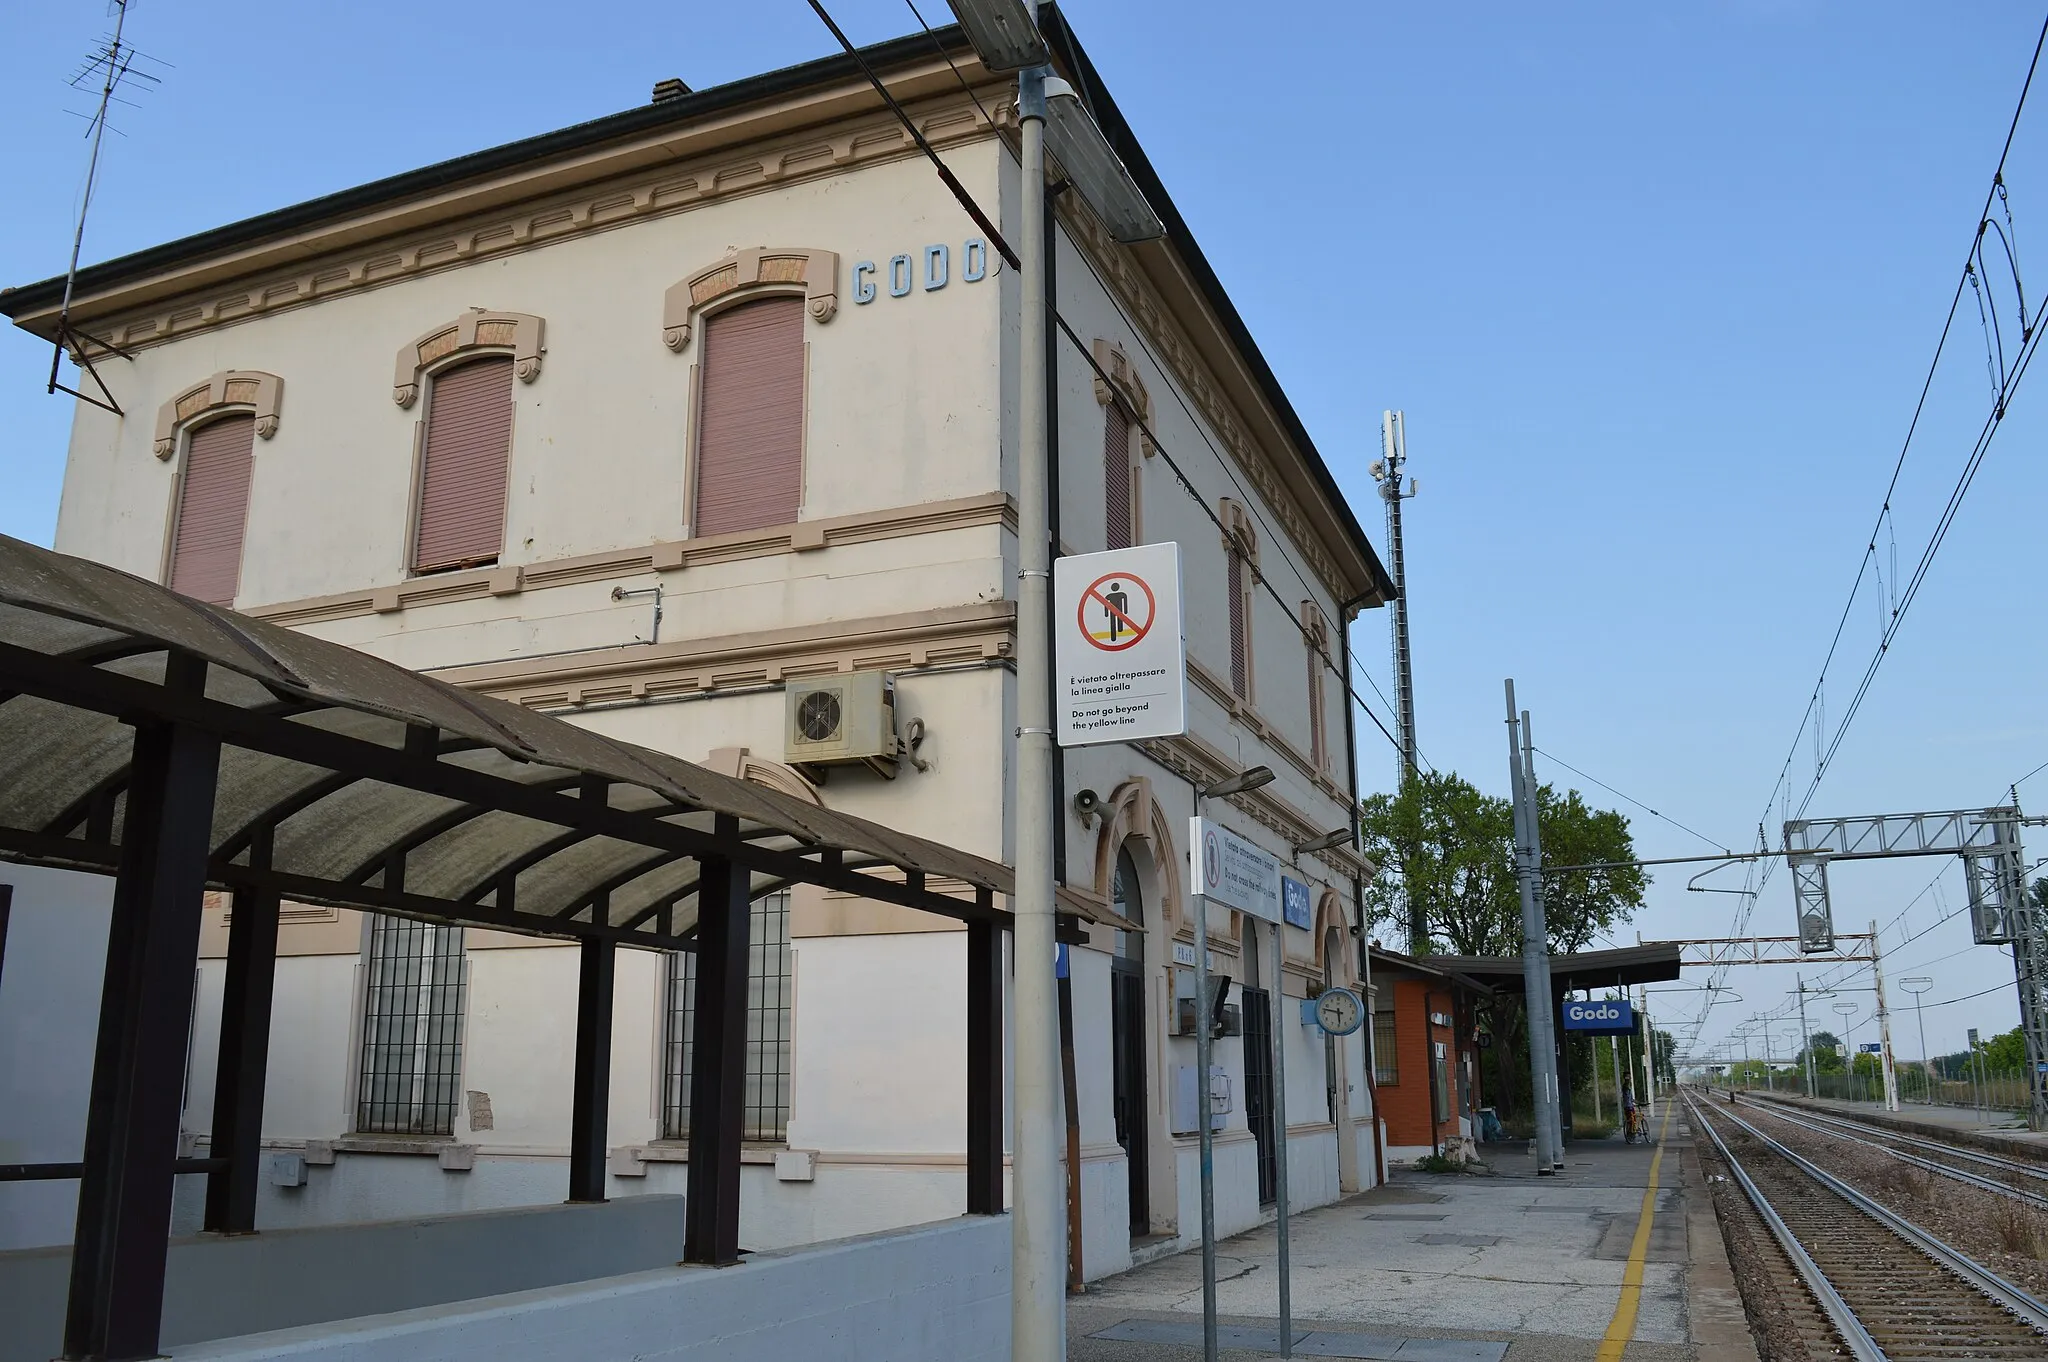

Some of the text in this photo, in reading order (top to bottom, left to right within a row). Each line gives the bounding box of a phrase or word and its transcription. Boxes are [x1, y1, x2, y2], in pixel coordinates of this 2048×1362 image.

[852, 237, 986, 305] GODO
[1077, 674, 1108, 684] vietato
[1110, 668, 1166, 681] oltrepassare
[1071, 683, 1131, 696] la linea gialla
[1072, 702, 1149, 718] Do not go beyond
[1072, 717, 1136, 730] the yellow line
[1287, 883, 1307, 913] Godo
[1569, 1004, 1620, 1021] Godo
